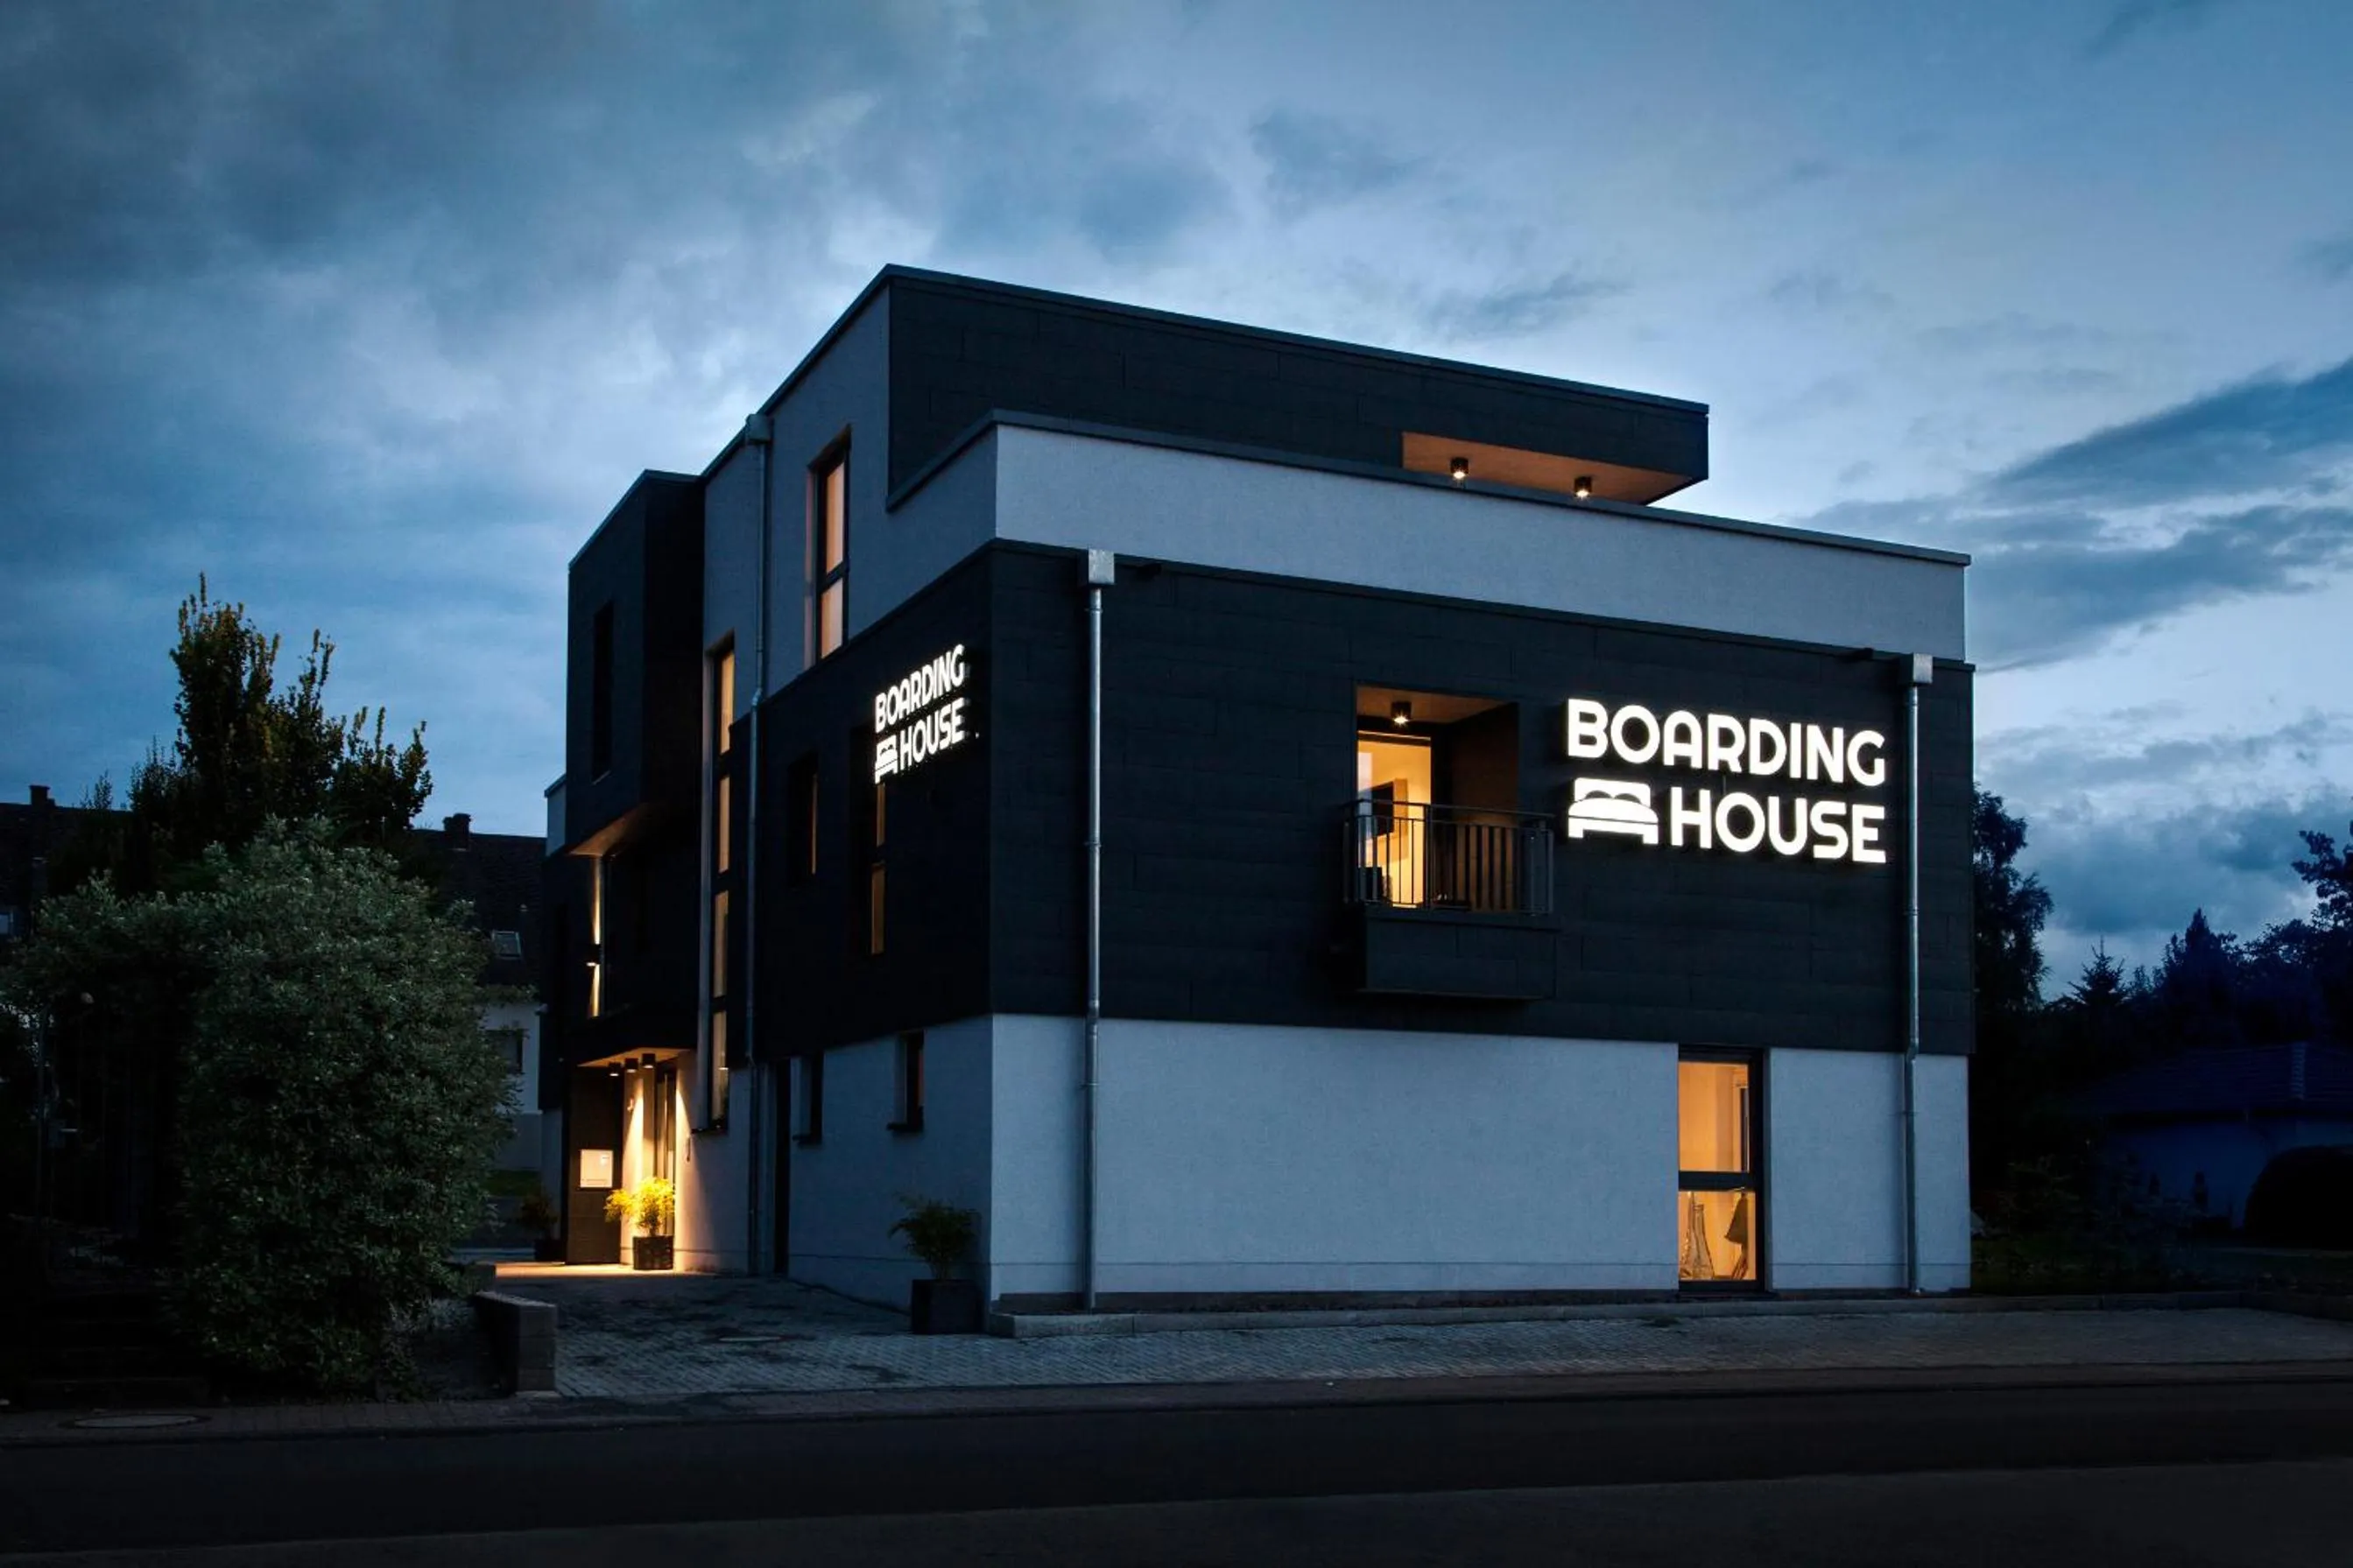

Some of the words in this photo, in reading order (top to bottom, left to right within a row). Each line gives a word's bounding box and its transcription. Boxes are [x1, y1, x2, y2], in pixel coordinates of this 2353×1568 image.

[875, 643, 966, 735] BOARDING
[899, 697, 966, 771] HOUSE
[1567, 698, 1886, 787] BOARDING
[1670, 786, 1887, 864] HOUSE
